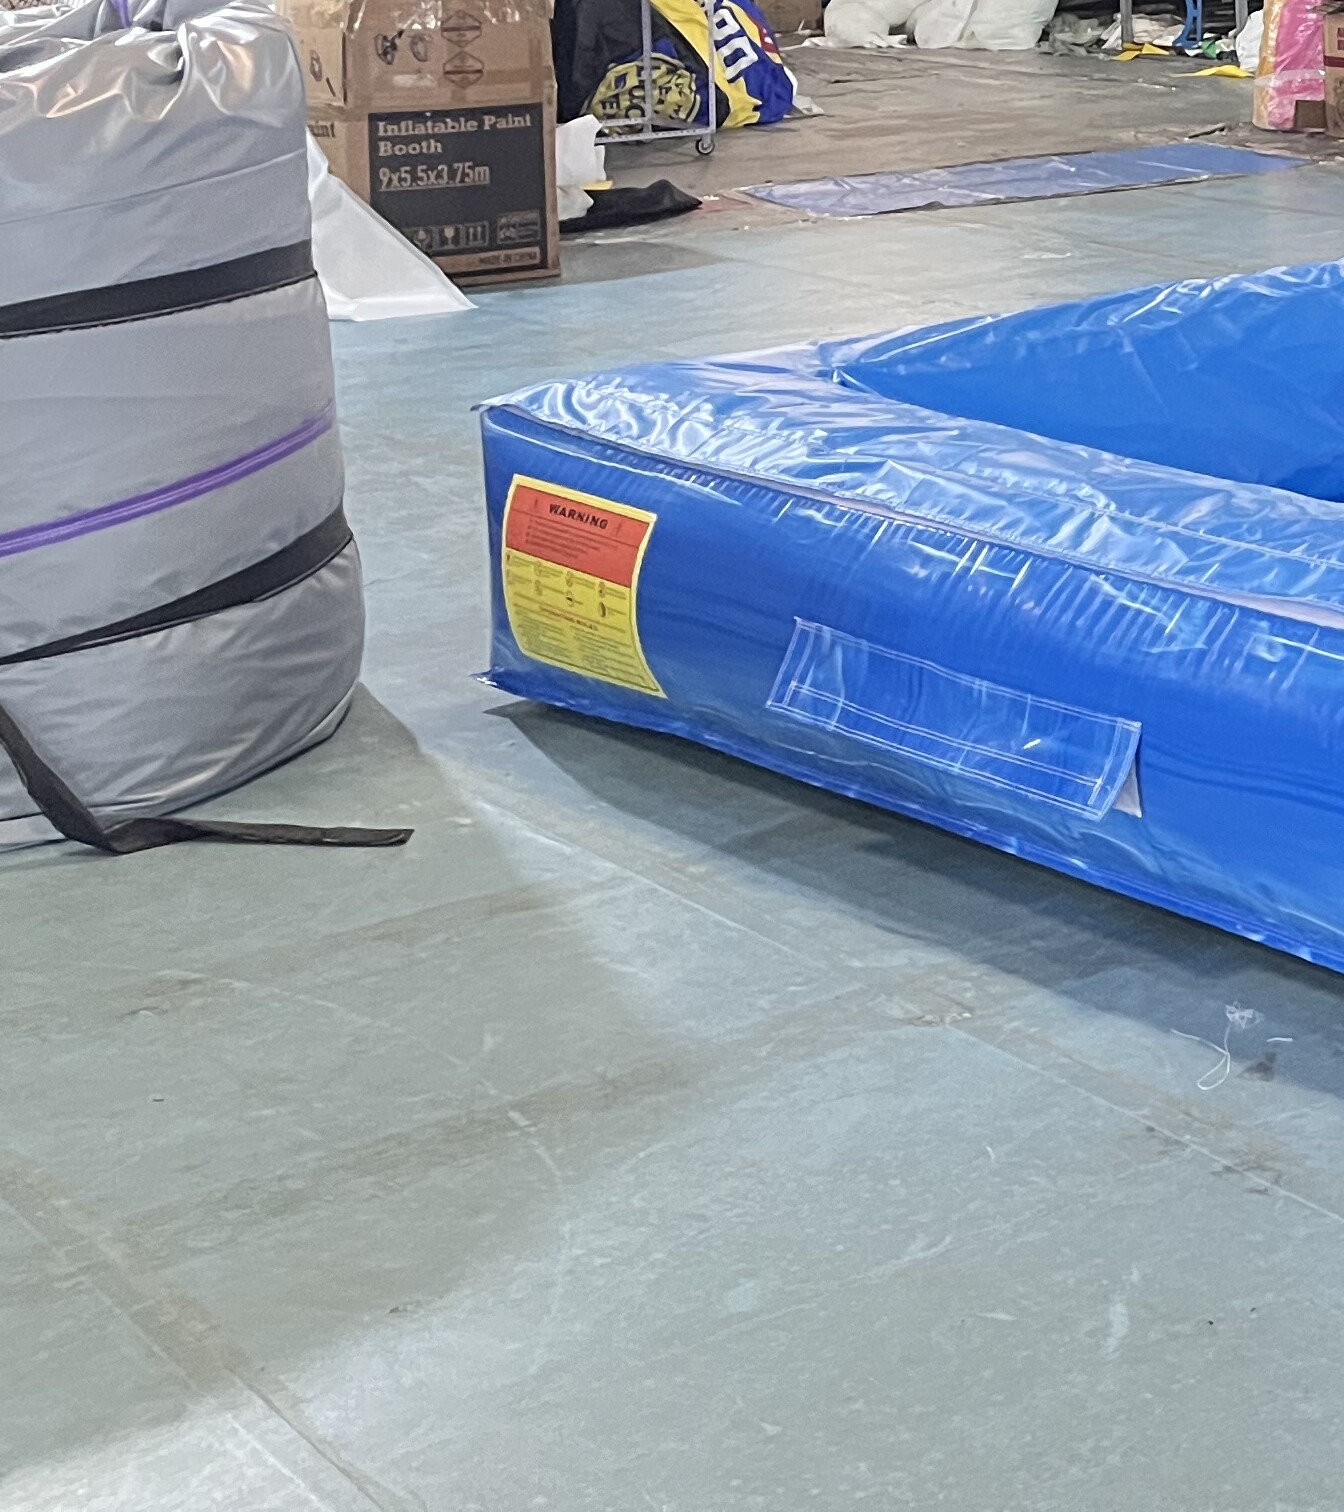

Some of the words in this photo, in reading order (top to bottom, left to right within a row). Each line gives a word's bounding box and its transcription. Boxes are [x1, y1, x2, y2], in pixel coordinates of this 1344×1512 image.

[376, 118, 478, 137] Inflatable
[482, 113, 532, 130] Paint
[377, 139, 443, 156] Booth
[378, 161, 491, 189] 9x5.5x3.75m
[549, 503, 608, 530] WARNING
